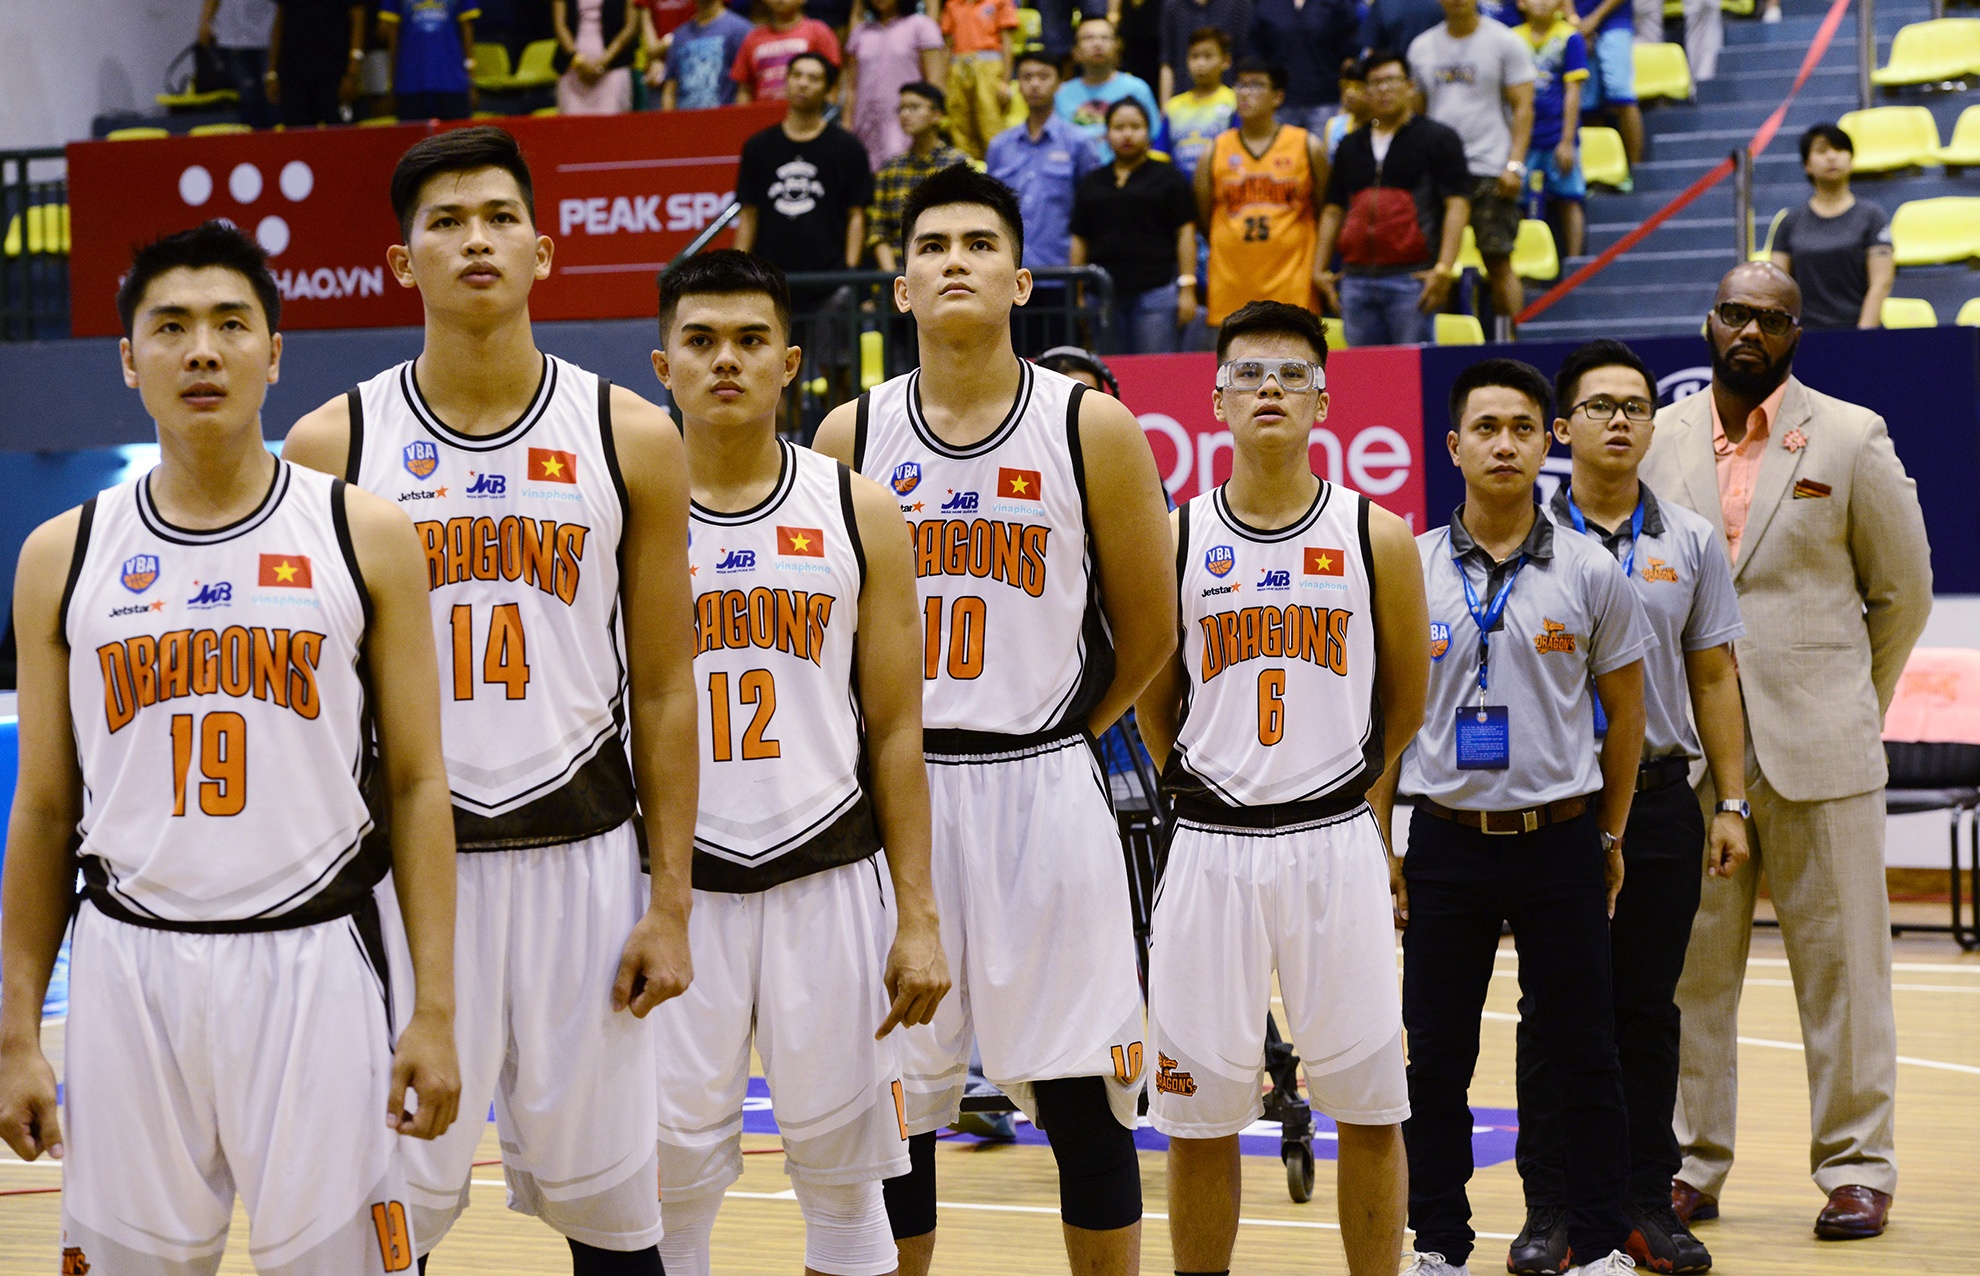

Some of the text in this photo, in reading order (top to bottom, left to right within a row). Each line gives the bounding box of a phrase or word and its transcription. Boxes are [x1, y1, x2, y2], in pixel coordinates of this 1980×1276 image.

[559, 194, 663, 236] PEAK
[407, 443, 435, 460] VBA
[895, 464, 918, 480] VBA
[398, 489, 436, 502] Jetstar
[521, 488, 582, 502] vinaphone
[992, 504, 1045, 517] vinaphone
[414, 515, 590, 606] RAGONS
[906, 518, 1052, 598] AGONS
[1208, 546, 1231, 562] VBA
[125, 556, 157, 575] VBA
[775, 562, 831, 574] vinaphone
[1201, 584, 1232, 597] Jetstar
[1299, 580, 1348, 591] vinaphone
[109, 604, 151, 617] Jetstar
[252, 595, 320, 608] vinaphone
[693, 586, 836, 669] AGONS
[1430, 624, 1449, 640] BA
[924, 596, 987, 680] 10
[1198, 603, 1354, 684] DRAGONS
[1536, 634, 1575, 651] DRAGONS
[450, 602, 530, 701] 14
[97, 625, 327, 735] DRAGONS
[708, 668, 781, 762] 12
[1258, 668, 1286, 747] 6
[171, 711, 247, 817] 19
[891, 1078, 908, 1141] 1
